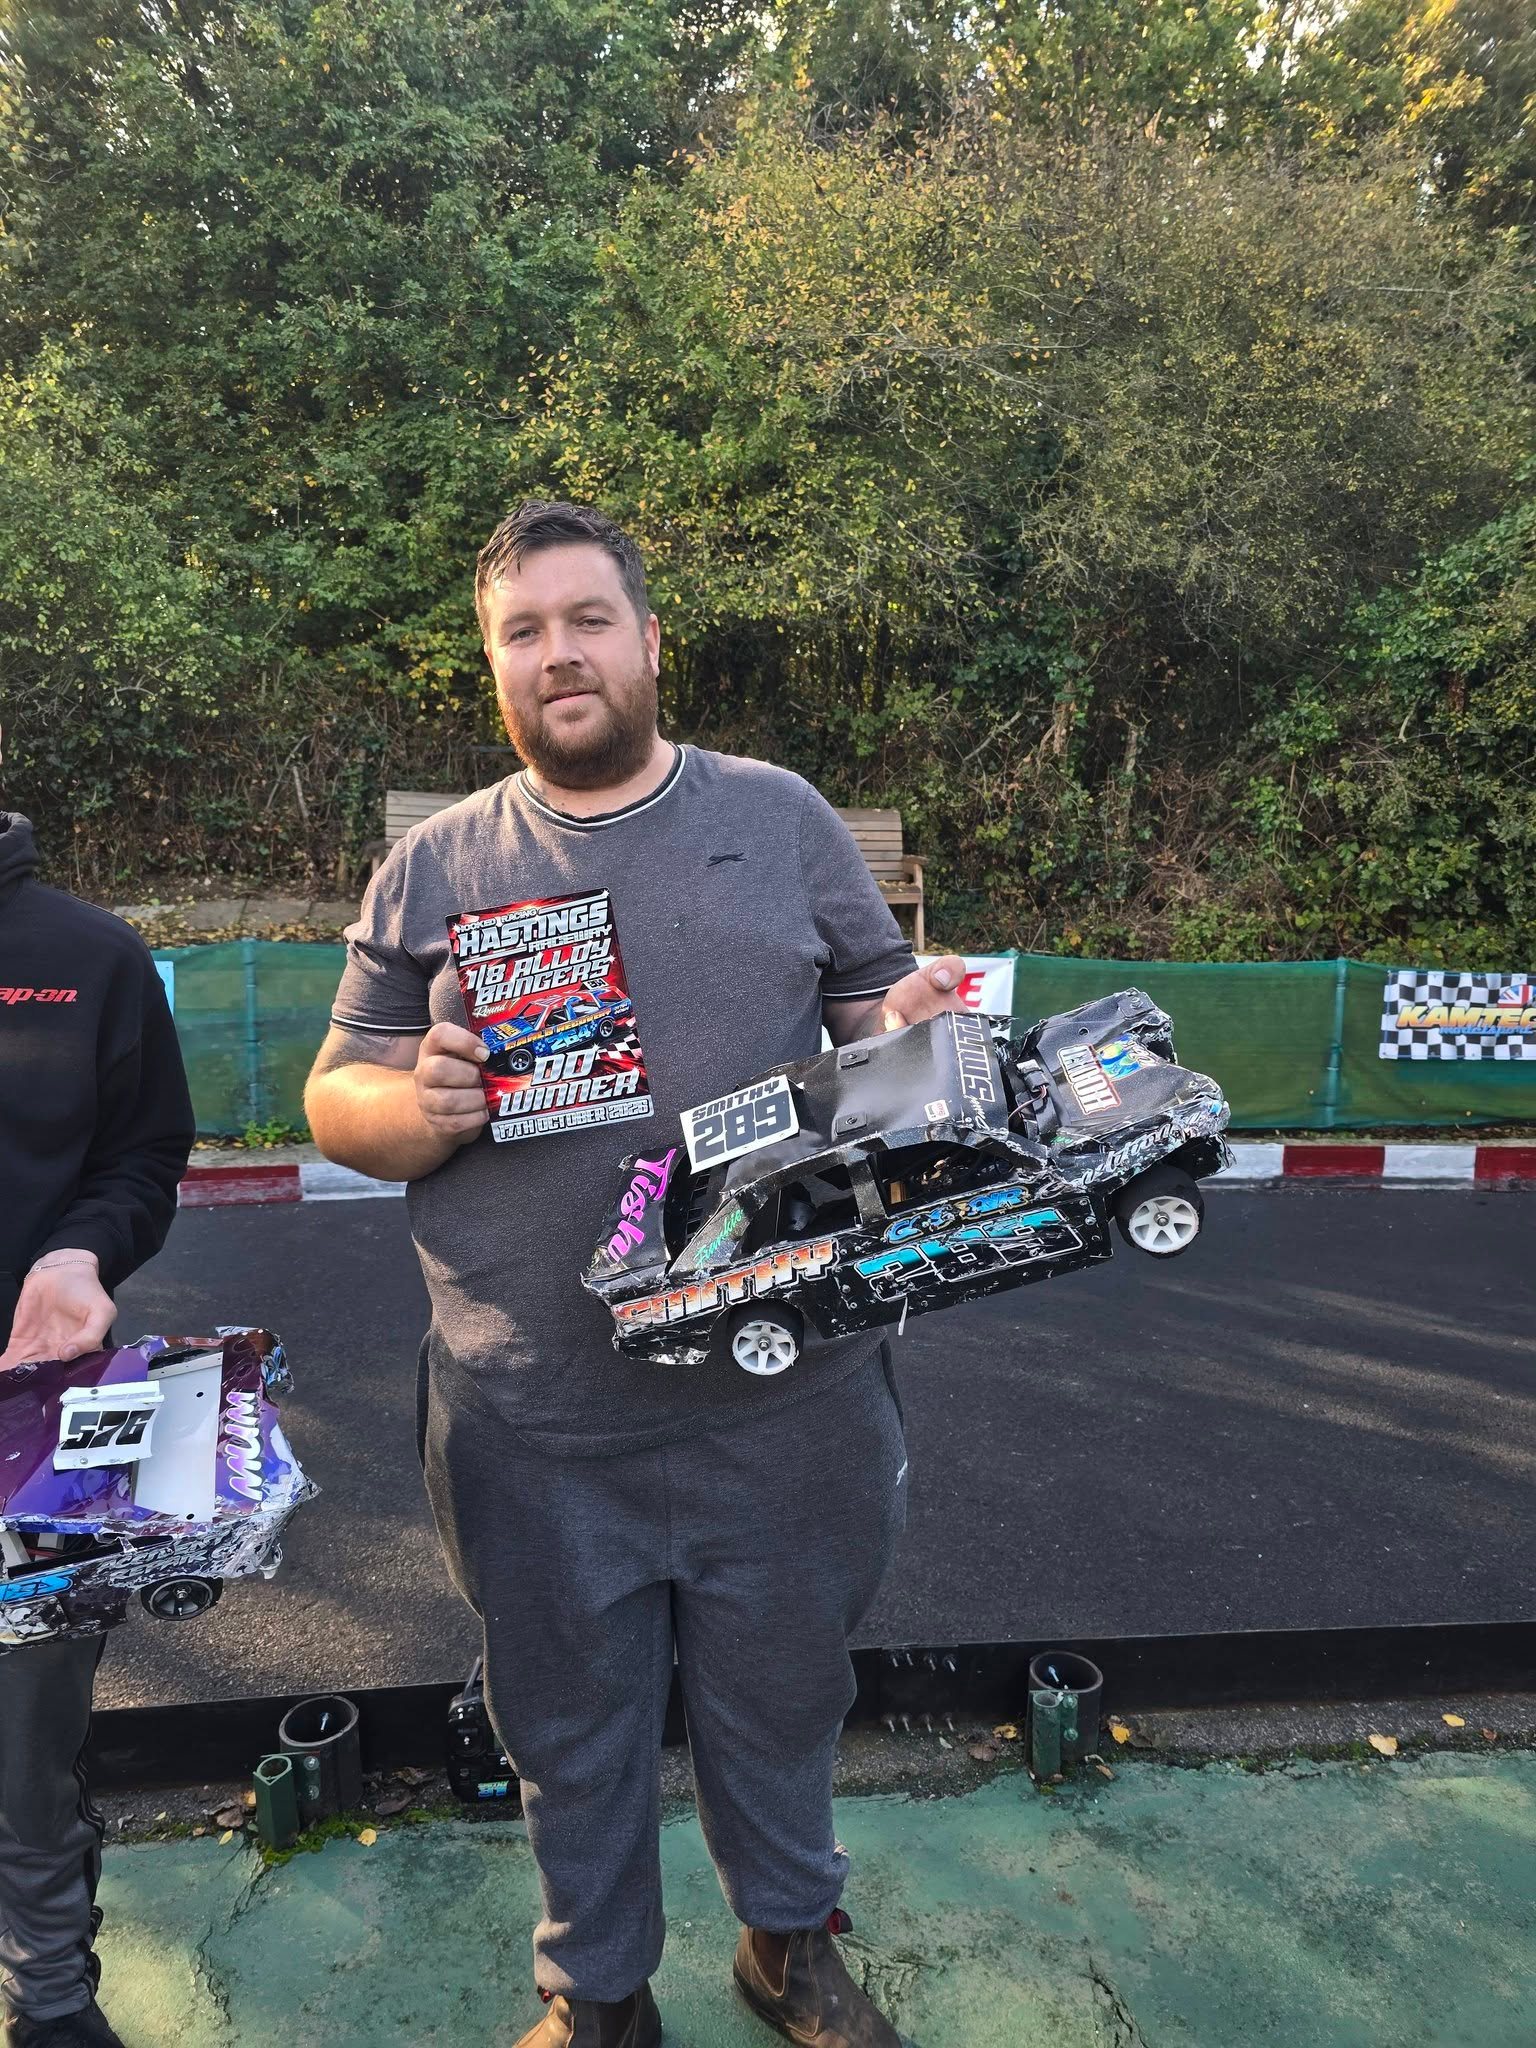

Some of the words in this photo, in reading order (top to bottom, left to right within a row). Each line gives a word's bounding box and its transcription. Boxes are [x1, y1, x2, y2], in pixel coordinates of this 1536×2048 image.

[458, 900, 609, 957] HASTINGS
[459, 918, 497, 934] HOOKED
[501, 908, 538, 923] RACING
[528, 924, 613, 953] RACEWAY
[466, 963, 508, 991] 1/8
[513, 937, 612, 978] ALLOY
[475, 959, 611, 1007] BANGERS
[472, 1002, 506, 1018] Round
[550, 1023, 592, 1050] 264
[498, 1070, 641, 1117] WINNER
[691, 1079, 780, 1123] SMITHY
[498, 1119, 536, 1140] 17TH
[536, 1106, 607, 1133] OCTOBER
[693, 1090, 791, 1164] 289
[606, 1148, 677, 1263] Tish
[60, 1408, 157, 1451] 576
